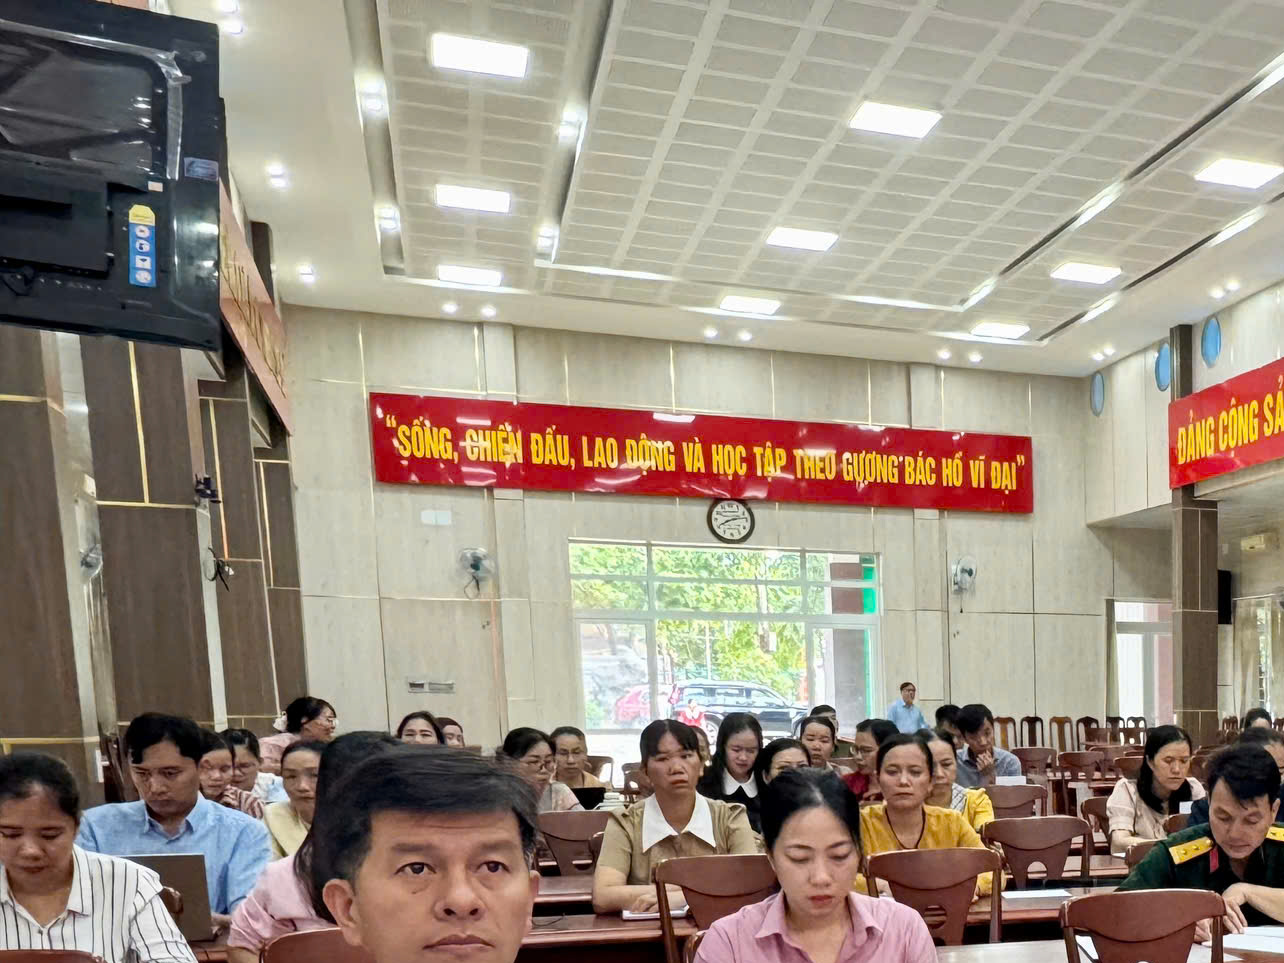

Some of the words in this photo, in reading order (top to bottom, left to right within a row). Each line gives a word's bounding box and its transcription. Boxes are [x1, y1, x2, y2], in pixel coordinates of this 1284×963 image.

[531, 425, 575, 470] ĐẤU,
[583, 436, 618, 469] LAO
[626, 432, 675, 476] ĐỘNG
[682, 436, 705, 473] VÀ
[712, 444, 747, 480] HỌC
[753, 441, 787, 483] TẬP
[793, 448, 836, 480] THEO
[905, 451, 936, 485] BÁC
[970, 455, 985, 489] VĨ
[1177, 409, 1215, 465] ĐẢNG
[1219, 397, 1259, 458] CỘNG
